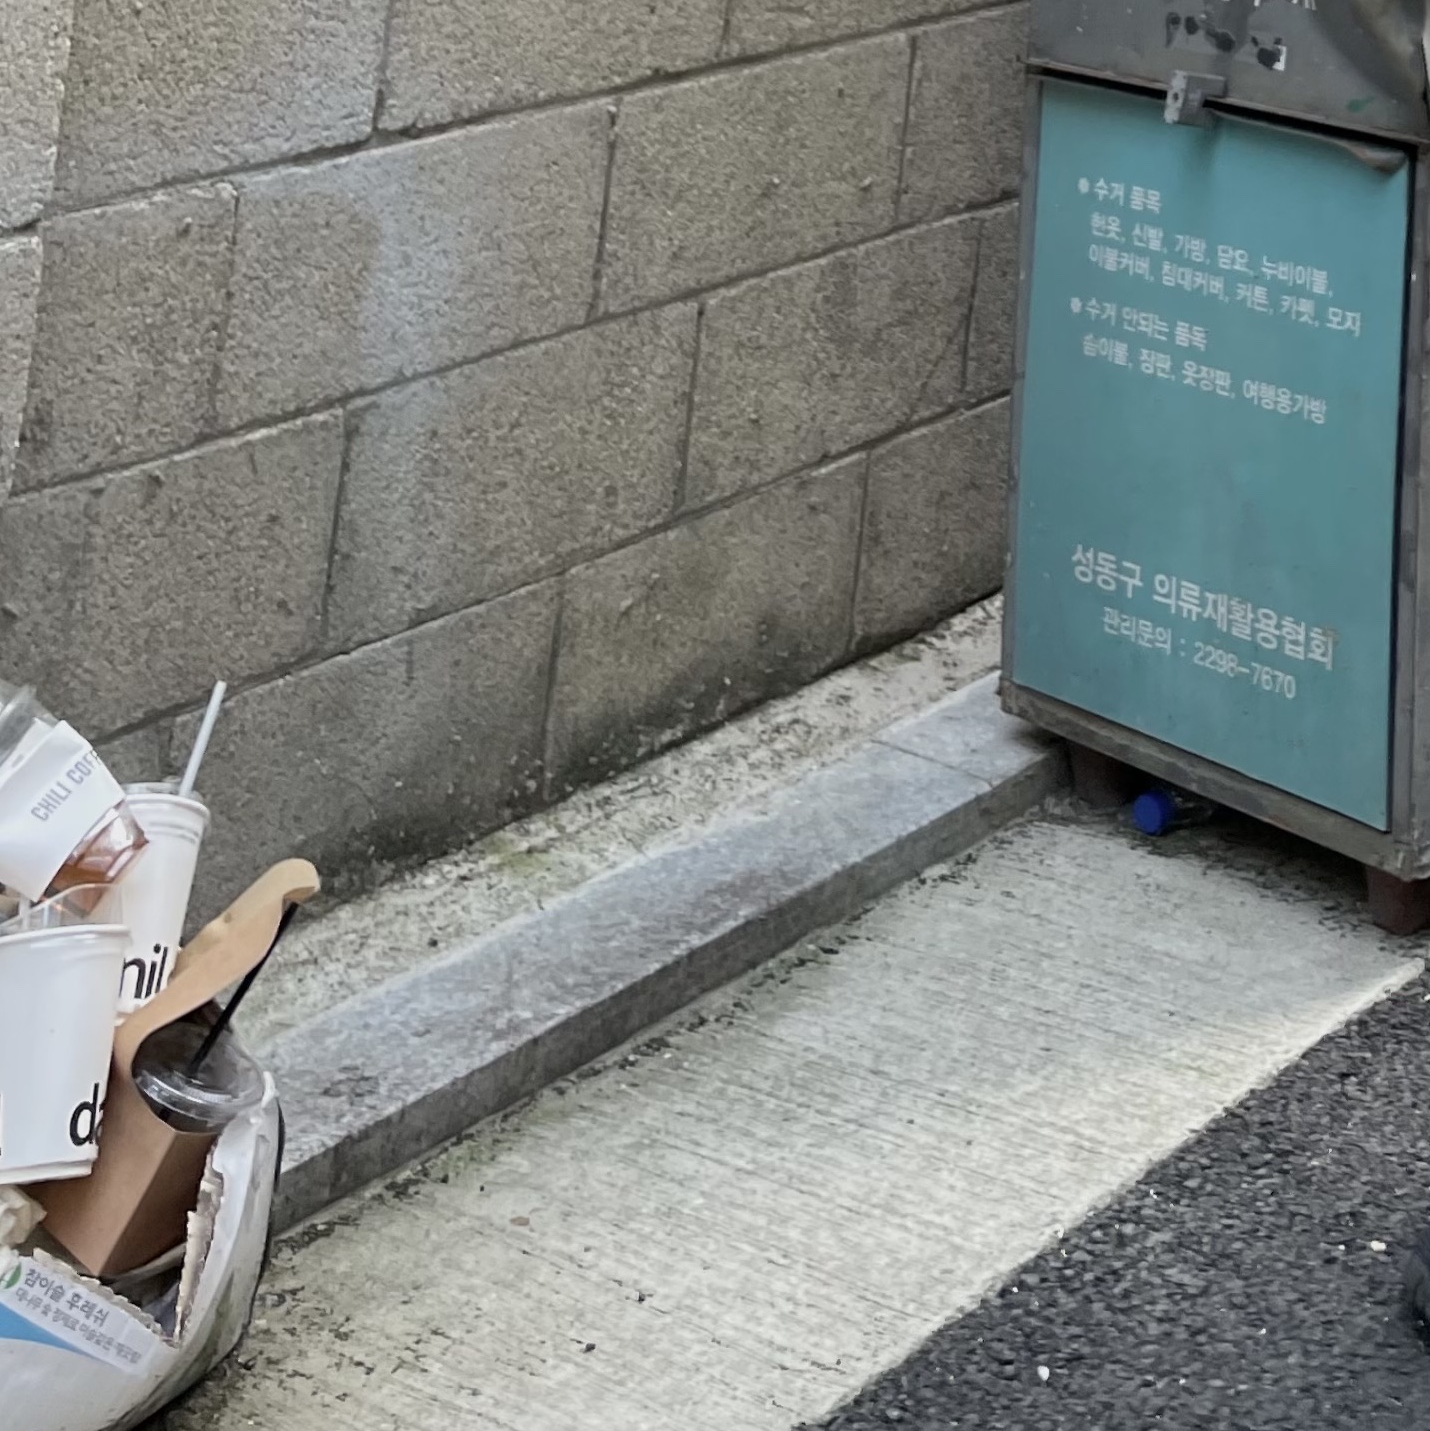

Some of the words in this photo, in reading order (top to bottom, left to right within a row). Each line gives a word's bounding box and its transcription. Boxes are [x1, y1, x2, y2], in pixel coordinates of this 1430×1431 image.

[1094, 177, 1124, 206] 수거
[1132, 222, 1168, 254] 신발,
[1174, 234, 1210, 265] 가방,
[1071, 544, 1143, 598] 성동구
[1152, 573, 1333, 671] 의류재활용협회
[1102, 606, 1171, 655] 관리문의
[1193, 641, 1297, 700] 2298-7670
[24, 1268, 66, 1303] 참이슬
